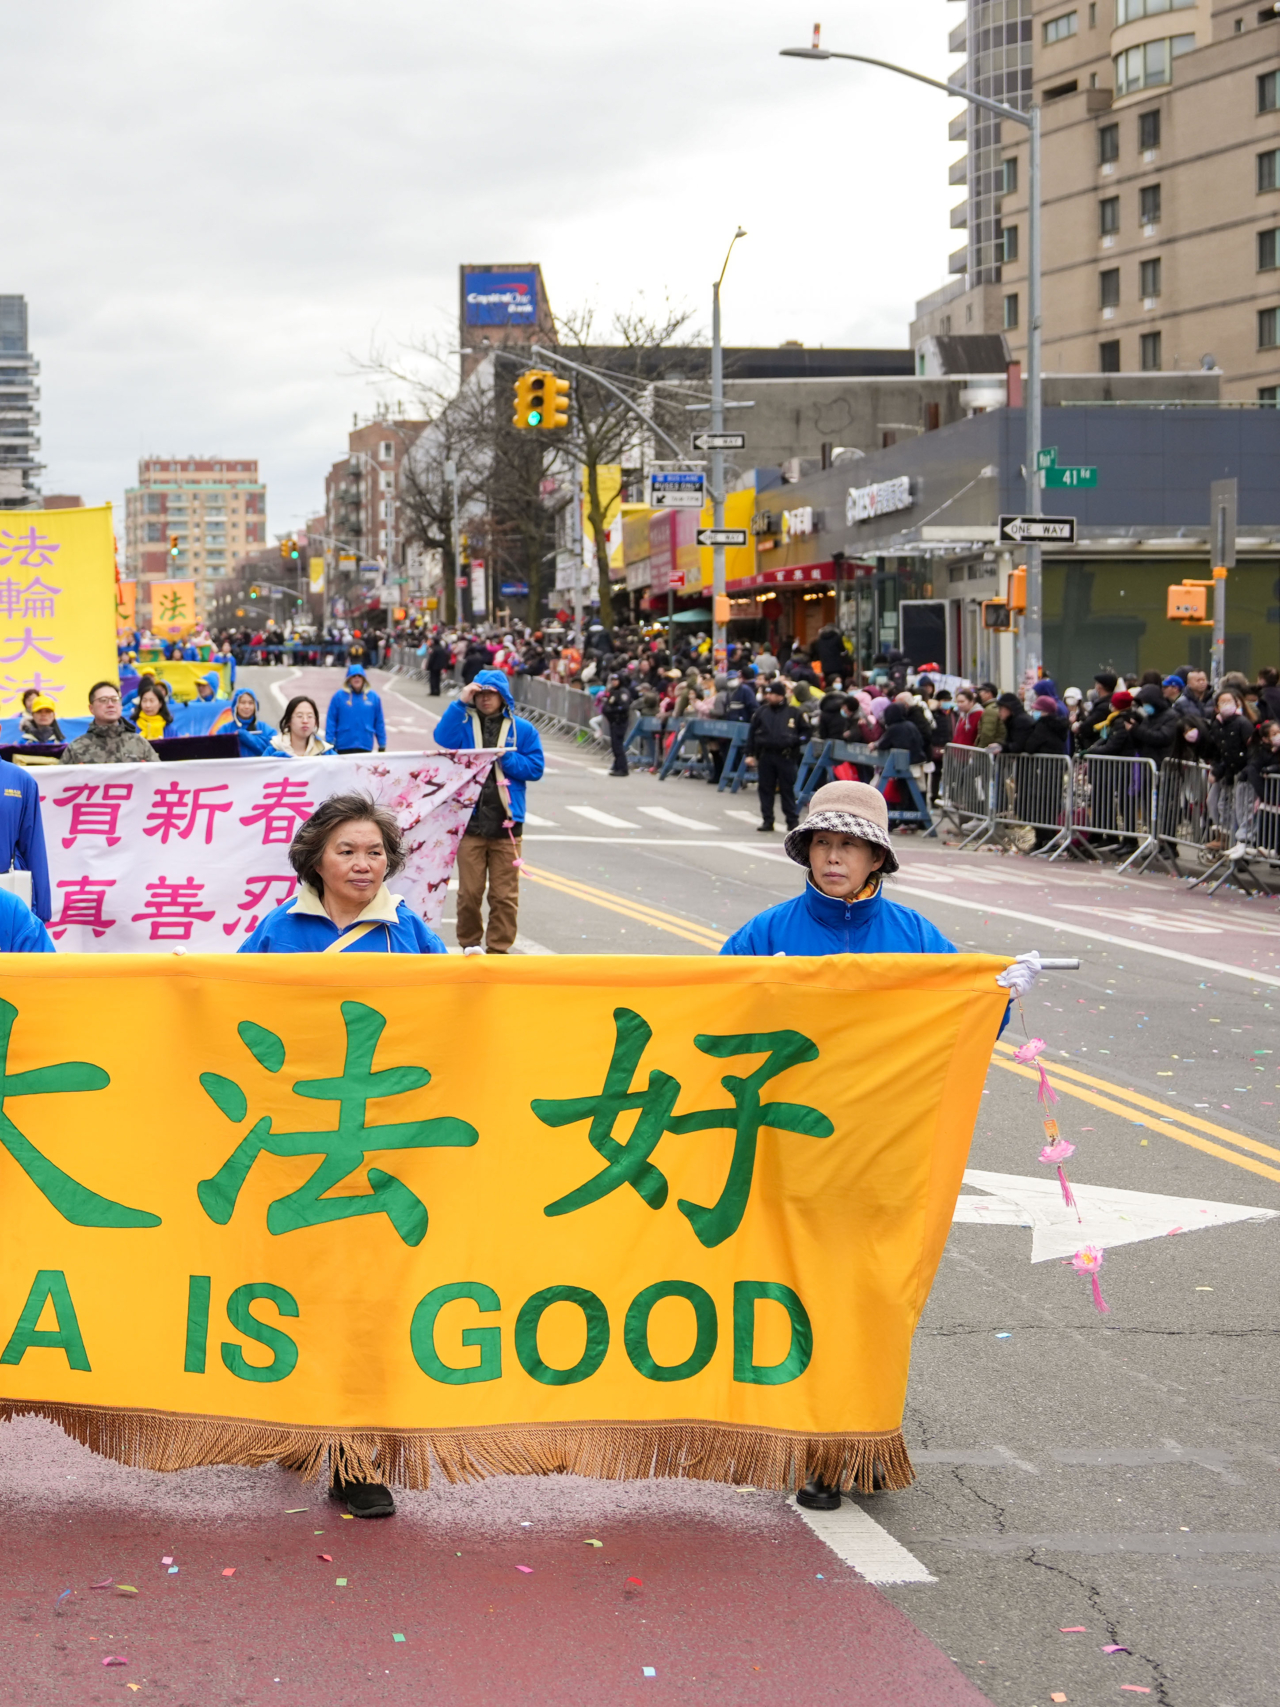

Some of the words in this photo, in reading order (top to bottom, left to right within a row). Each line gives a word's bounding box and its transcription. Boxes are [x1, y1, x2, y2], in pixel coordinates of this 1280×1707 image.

[701, 437, 715, 445] ONE
[722, 437, 738, 445] WAY
[1062, 469, 1078, 485] 41
[1080, 468, 1091, 479] Rd
[654, 482, 680, 490] BUSES
[1011, 524, 1032, 535] ONE
[1042, 524, 1065, 535] WAY
[704, 533, 718, 541] ONE
[725, 533, 740, 541] WAY
[159, 591, 187, 622] 法
[183, 1273, 300, 1383] IS
[409, 1279, 814, 1386] GOOD
